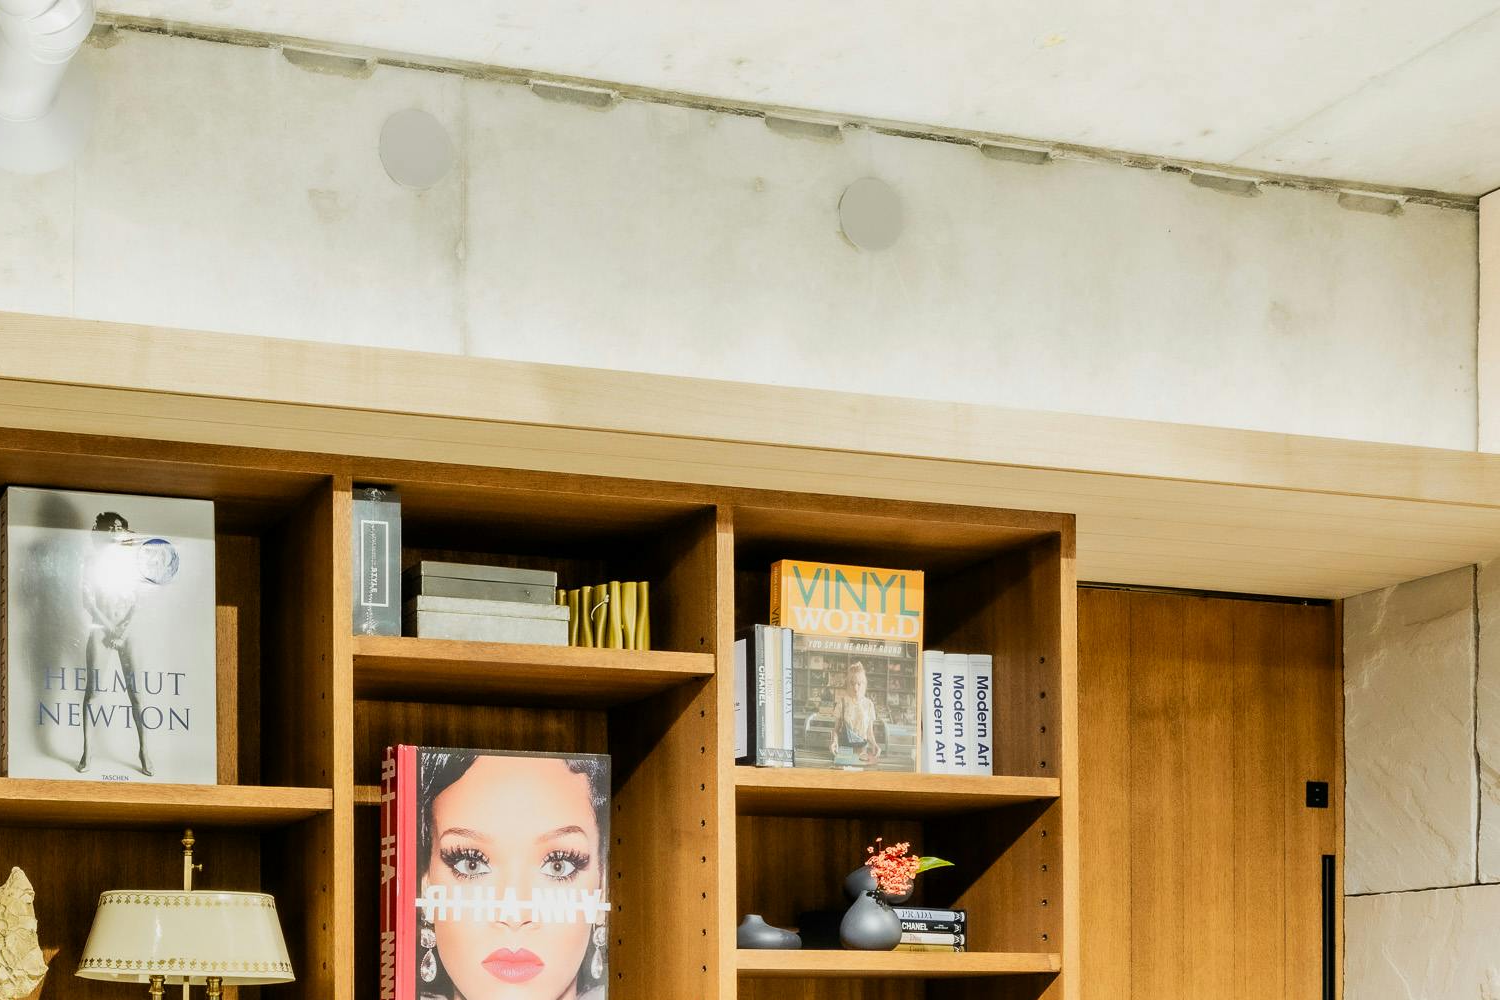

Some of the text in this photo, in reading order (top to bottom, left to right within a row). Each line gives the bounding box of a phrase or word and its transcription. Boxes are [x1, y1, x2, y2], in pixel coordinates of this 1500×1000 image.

[792, 566, 920, 616] VINYL
[790, 606, 920, 638] WORLD
[808, 641, 902, 654] YOU SPIN ME RIGHT ROUND
[43, 667, 186, 696] HELMUT
[758, 665, 766, 707] CHANEL
[37, 701, 191, 731] NEWTON
[932, 672, 946, 765] Modern Art
[953, 675, 966, 768] Modern Art
[976, 675, 990, 767] Modern Art
[901, 910, 933, 919] PRADA
[901, 922, 929, 931] CHANEL
